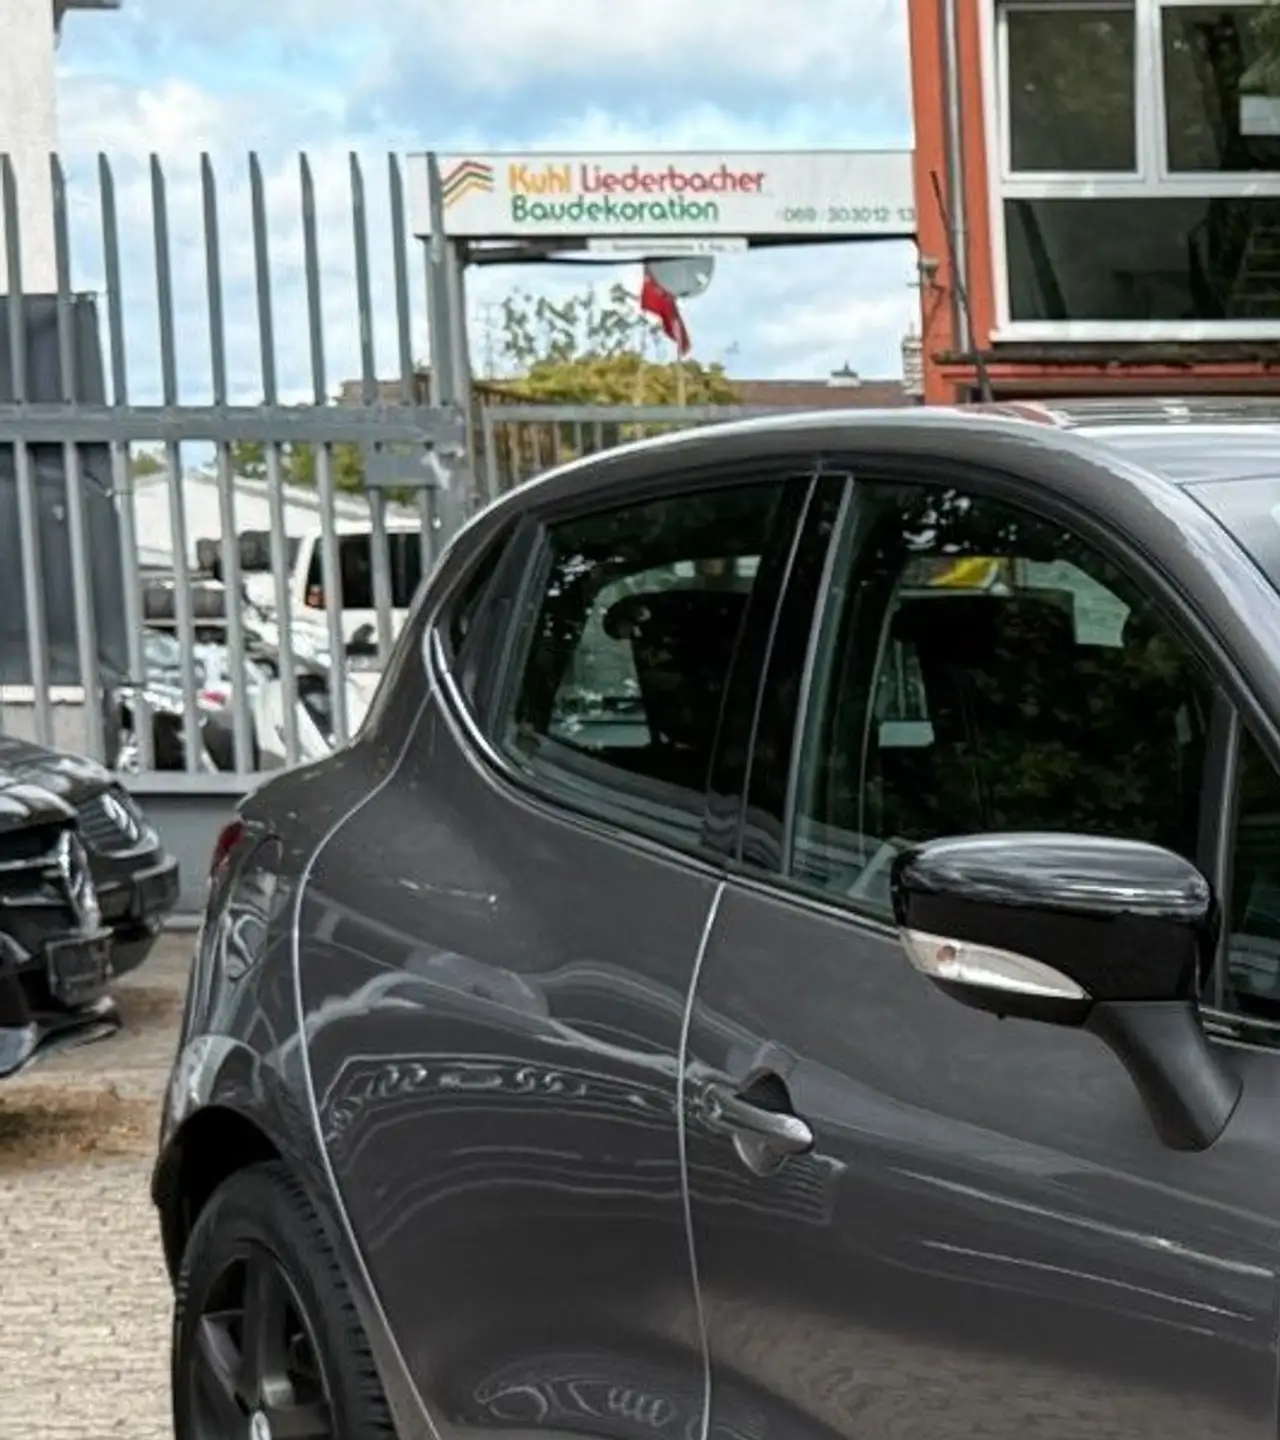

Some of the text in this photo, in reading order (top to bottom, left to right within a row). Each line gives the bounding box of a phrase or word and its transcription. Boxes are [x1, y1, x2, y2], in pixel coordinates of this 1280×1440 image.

[508, 162, 766, 194] Kuhl Liederbacher
[511, 193, 719, 223] Baudekoration
